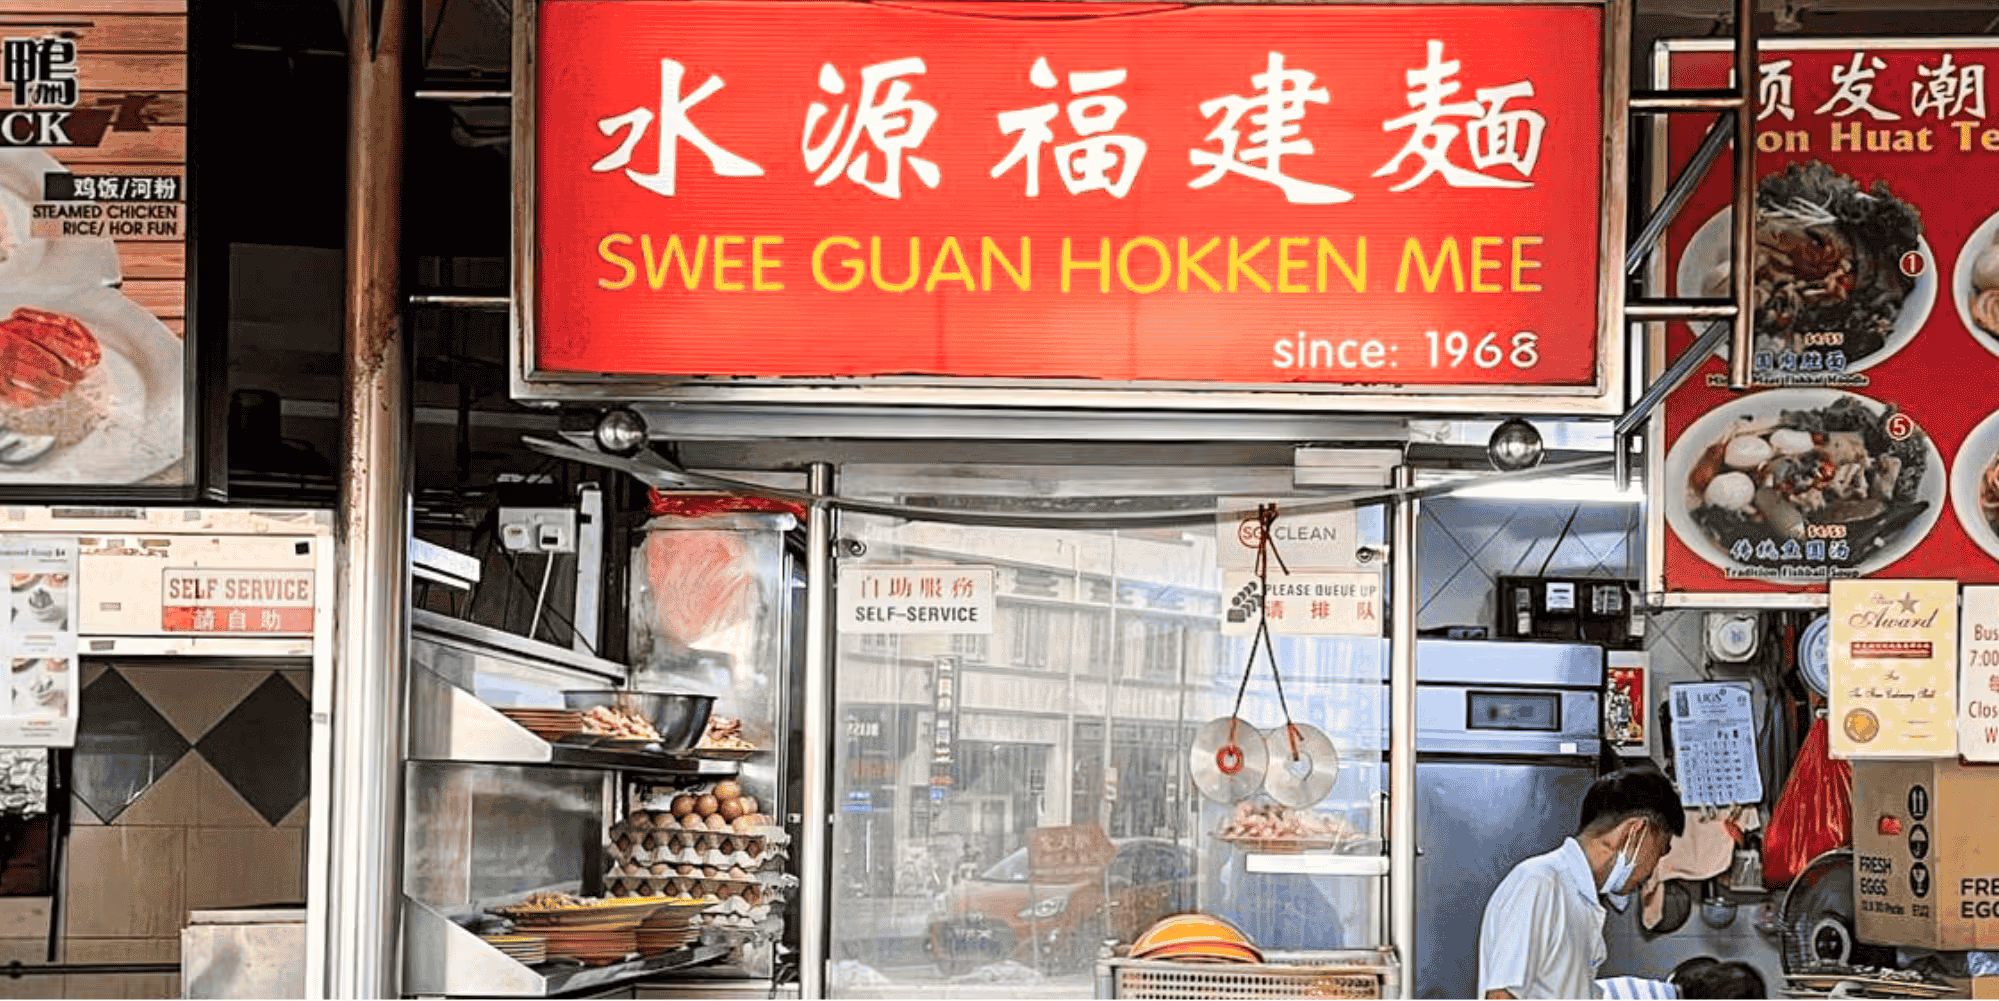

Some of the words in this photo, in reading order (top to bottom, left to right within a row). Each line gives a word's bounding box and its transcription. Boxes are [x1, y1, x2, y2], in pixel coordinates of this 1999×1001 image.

[1, 111, 73, 144] CK
[1831, 121, 1934, 152] Huat
[73, 177, 176, 200] 鸡饭/河粉
[32, 205, 102, 219] STEAMED
[106, 205, 177, 219] CHICKEN
[63, 221, 105, 236] RICE/
[109, 221, 143, 236] HOR
[147, 221, 177, 236] FUN
[598, 234, 785, 292] SWEE
[811, 236, 1032, 293] GUAN
[1060, 236, 1367, 294] HOKKEN
[1395, 237, 1542, 293] MEE
[1272, 330, 1398, 369] since:
[1425, 330, 1540, 368] 1968
[1892, 417, 1906, 436] 5
[1274, 526, 1337, 541] CLEAN
[169, 578, 217, 600] SELF
[225, 578, 309, 600] SERVICE
[1265, 583, 1310, 597] PLEASE
[1315, 583, 1356, 597] QUEUE
[1360, 583, 1377, 597] UP
[855, 605, 979, 623] SELF-SERVICE
[1849, 606, 1940, 629] Award
[1974, 623, 1999, 641] Bus
[1969, 649, 1999, 667] 7:00
[1968, 700, 1999, 719] Clos
[1859, 856, 1892, 874] FRESH
[1860, 877, 1888, 896] EGGS
